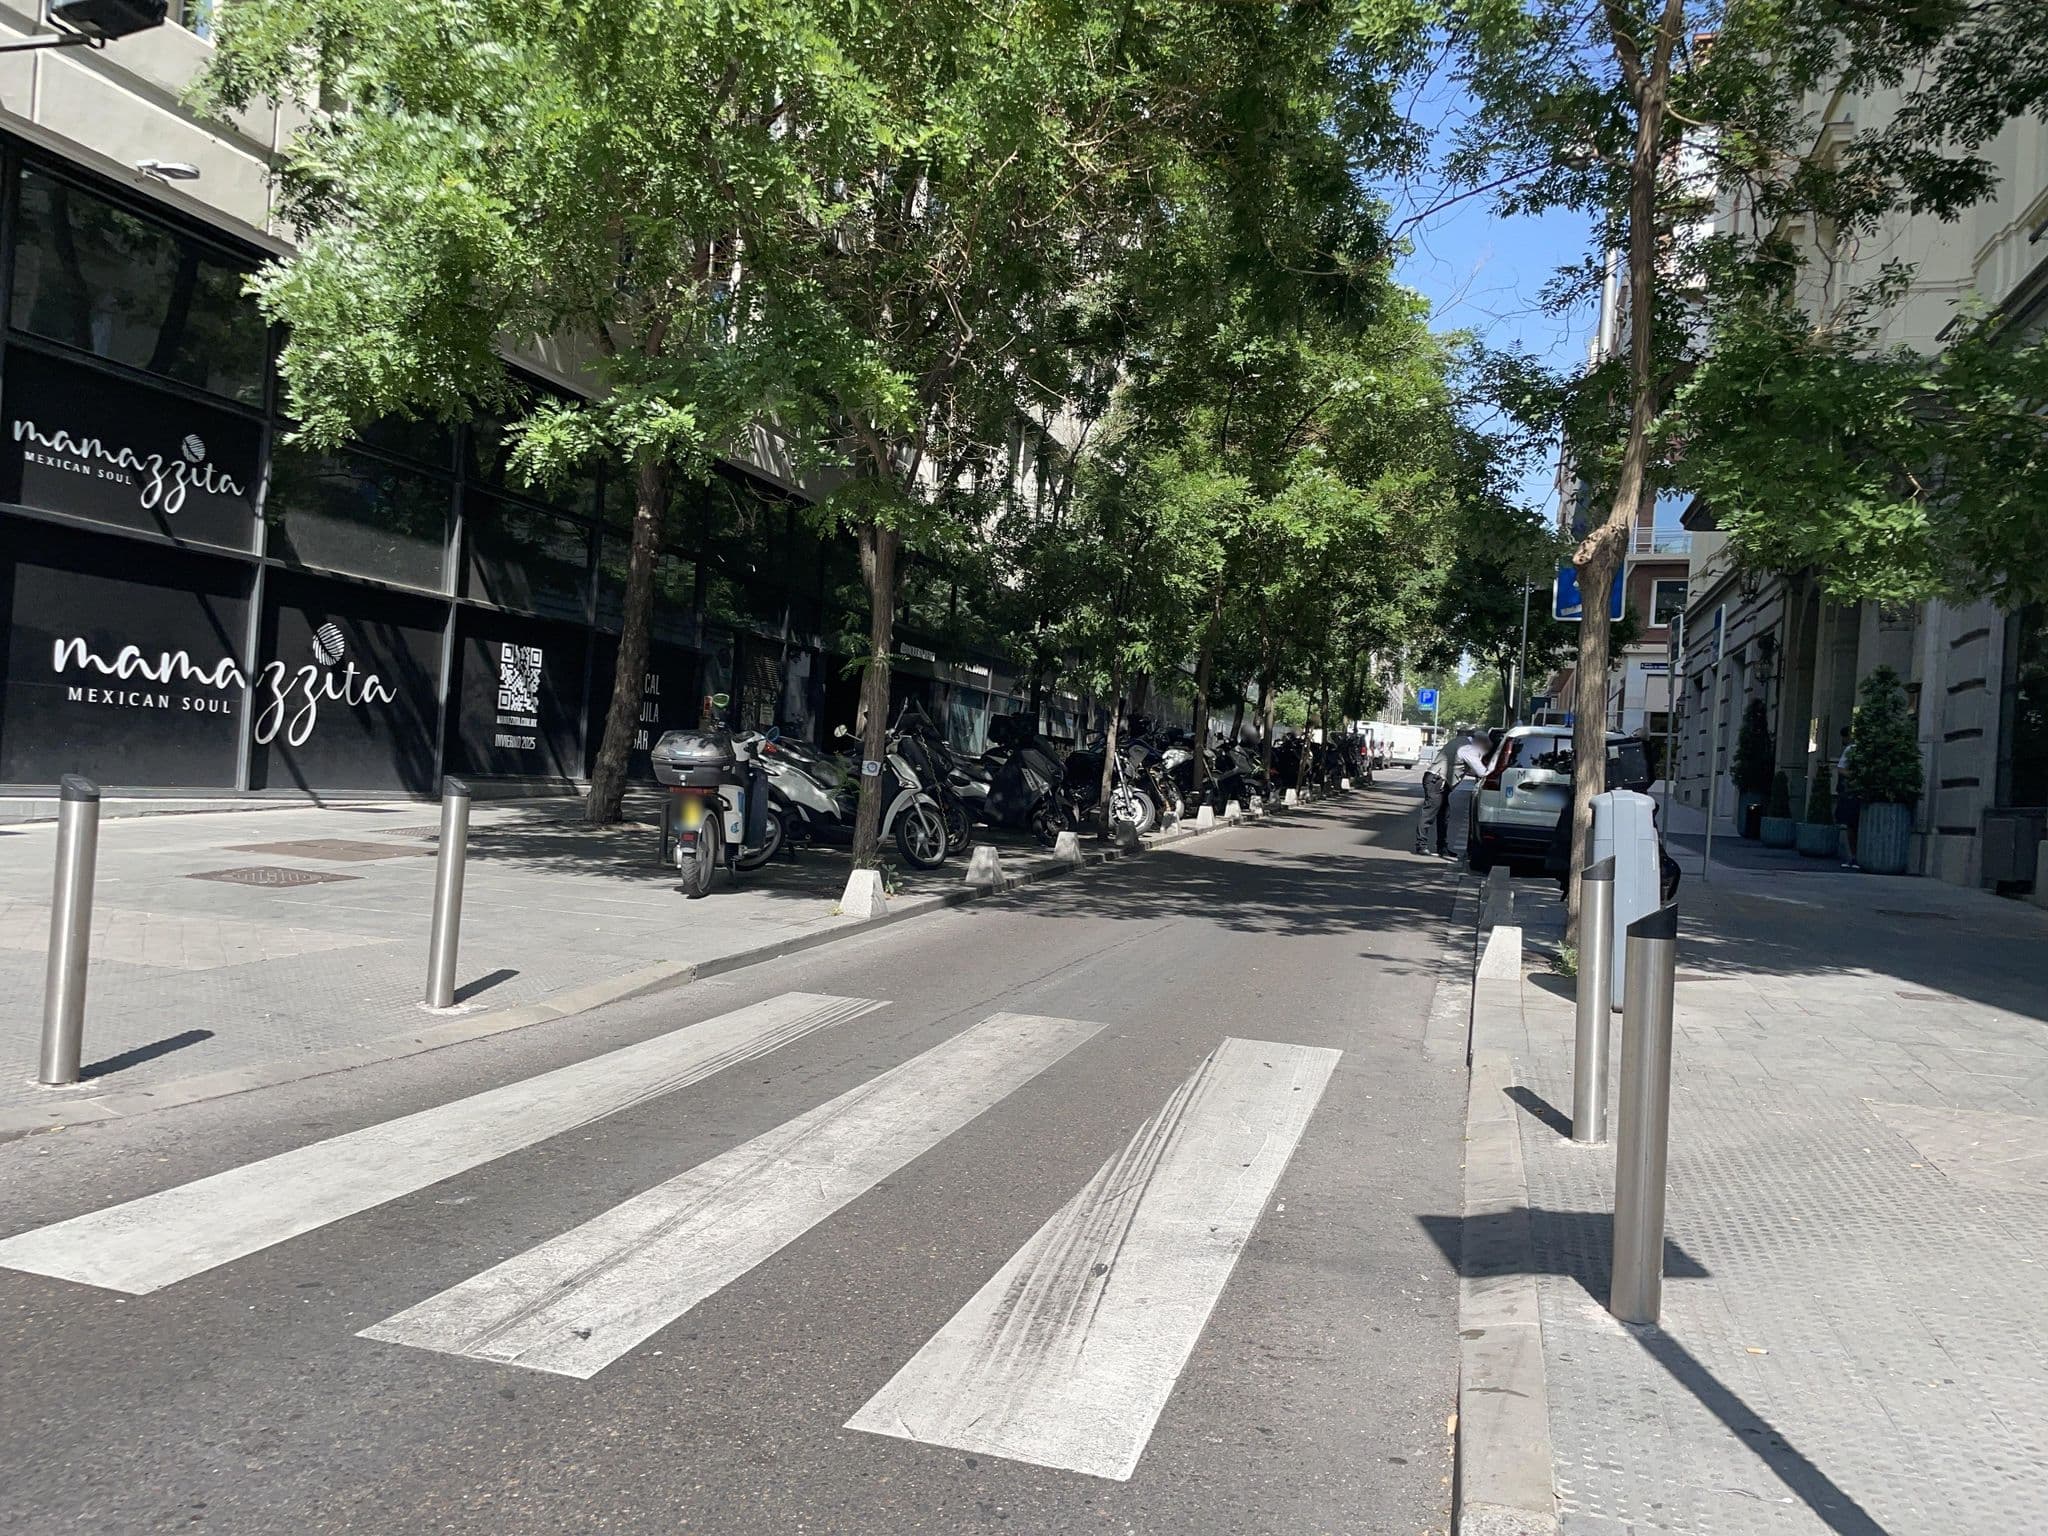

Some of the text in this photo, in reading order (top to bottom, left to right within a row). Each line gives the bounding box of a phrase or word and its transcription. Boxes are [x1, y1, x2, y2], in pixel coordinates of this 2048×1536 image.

[13, 420, 245, 514] mamazzita
[24, 451, 132, 486] MEXICAN SOUL
[53, 637, 397, 747] mamazzita
[644, 673, 661, 696] CAL
[68, 687, 231, 715] MEXICAN SOUL
[521, 736, 536, 750] 2025
[633, 728, 649, 751] AR
